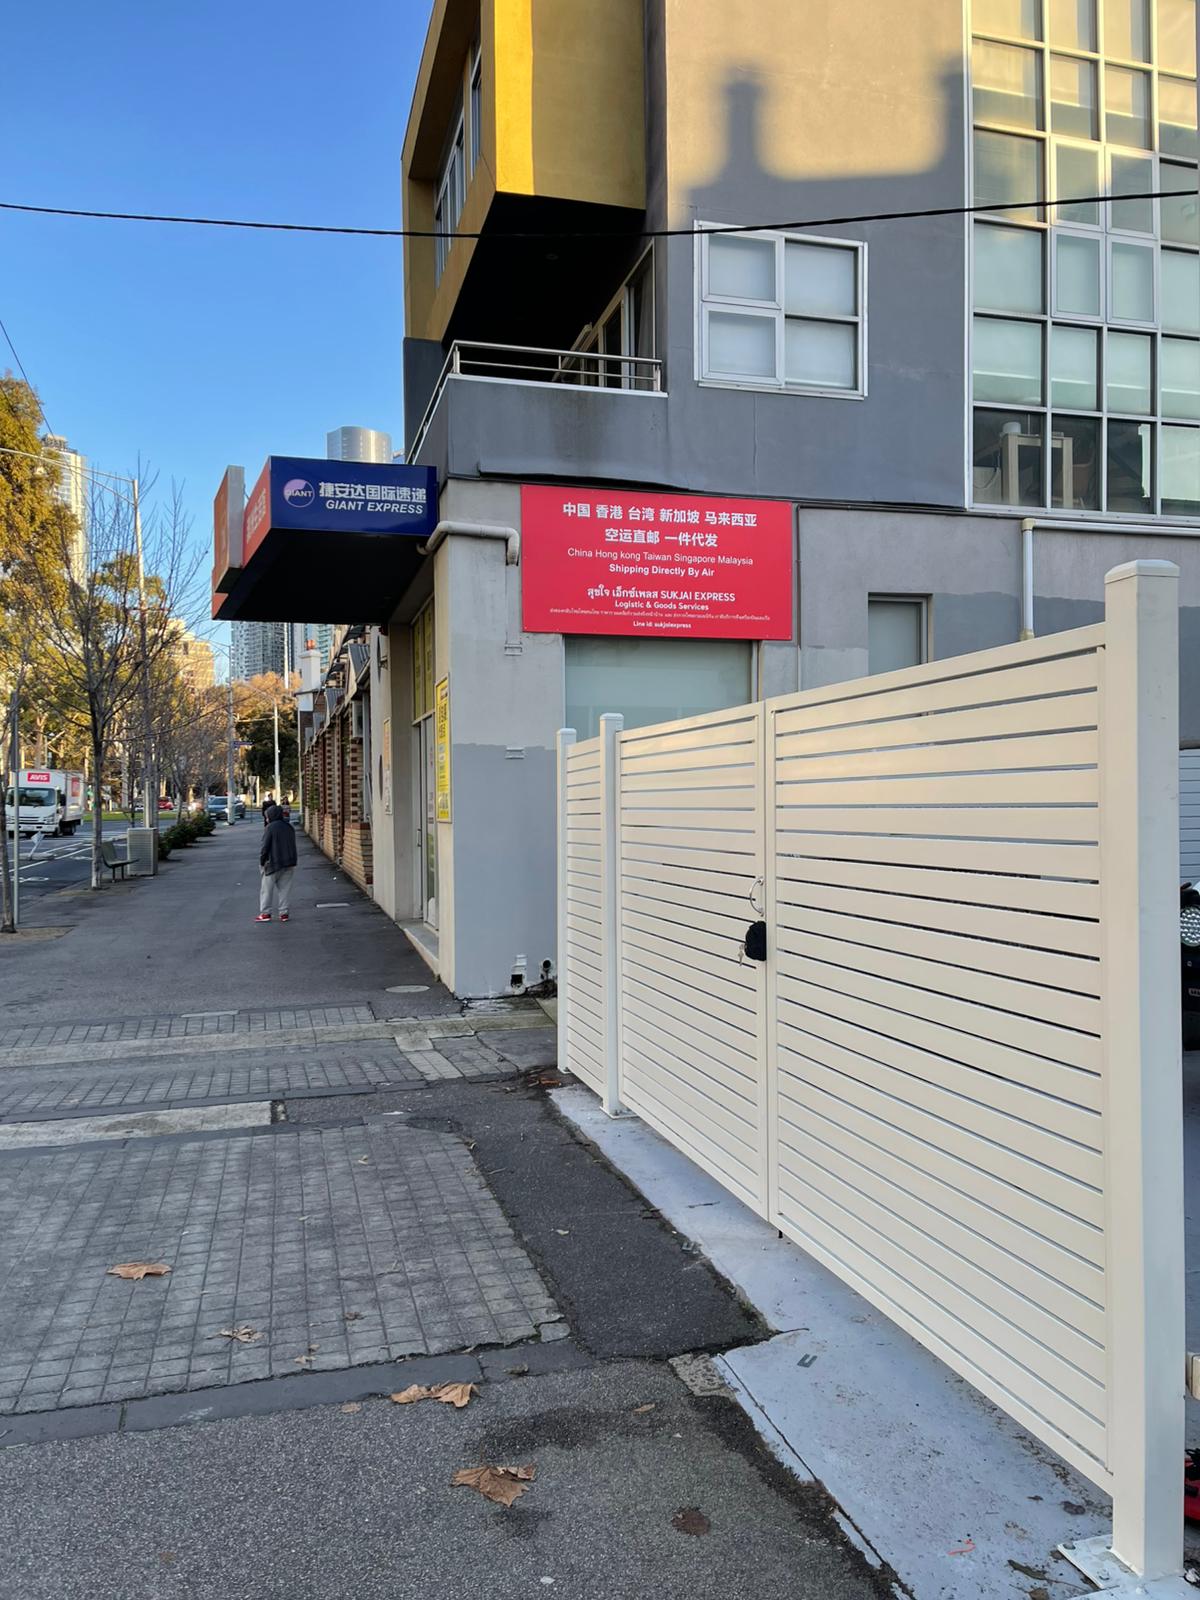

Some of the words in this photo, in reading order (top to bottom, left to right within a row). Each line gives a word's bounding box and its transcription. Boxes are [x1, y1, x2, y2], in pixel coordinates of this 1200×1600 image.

[319, 482, 427, 503] 捷安达国际速递
[326, 500, 364, 511] GIANT
[367, 502, 423, 514] EXPRESS
[563, 502, 590, 518] 中国
[596, 504, 623, 519] 香港
[628, 506, 655, 521] 台湾
[659, 508, 700, 524] 新加坡
[704, 511, 758, 526] 马来西亚
[604, 528, 660, 544] 空运直邮
[664, 532, 718, 547] 一件代发
[567, 547, 593, 558] China
[595, 549, 618, 560] Hong
[620, 550, 640, 561] kong
[643, 551, 672, 562] Taiwan
[674, 553, 716, 565] Singapore
[718, 555, 753, 566] Malaysia
[609, 564, 649, 575] Shipping
[651, 565, 685, 577] Directly
[688, 567, 699, 577] By
[701, 567, 715, 577] Air
[587, 584, 610, 598] สุขใจ
[661, 590, 692, 600] SUKJAI
[695, 592, 735, 602] EXPRESS
[615, 600, 644, 609] Logistic
[653, 601, 677, 610] Goods
[679, 602, 709, 610] Services
